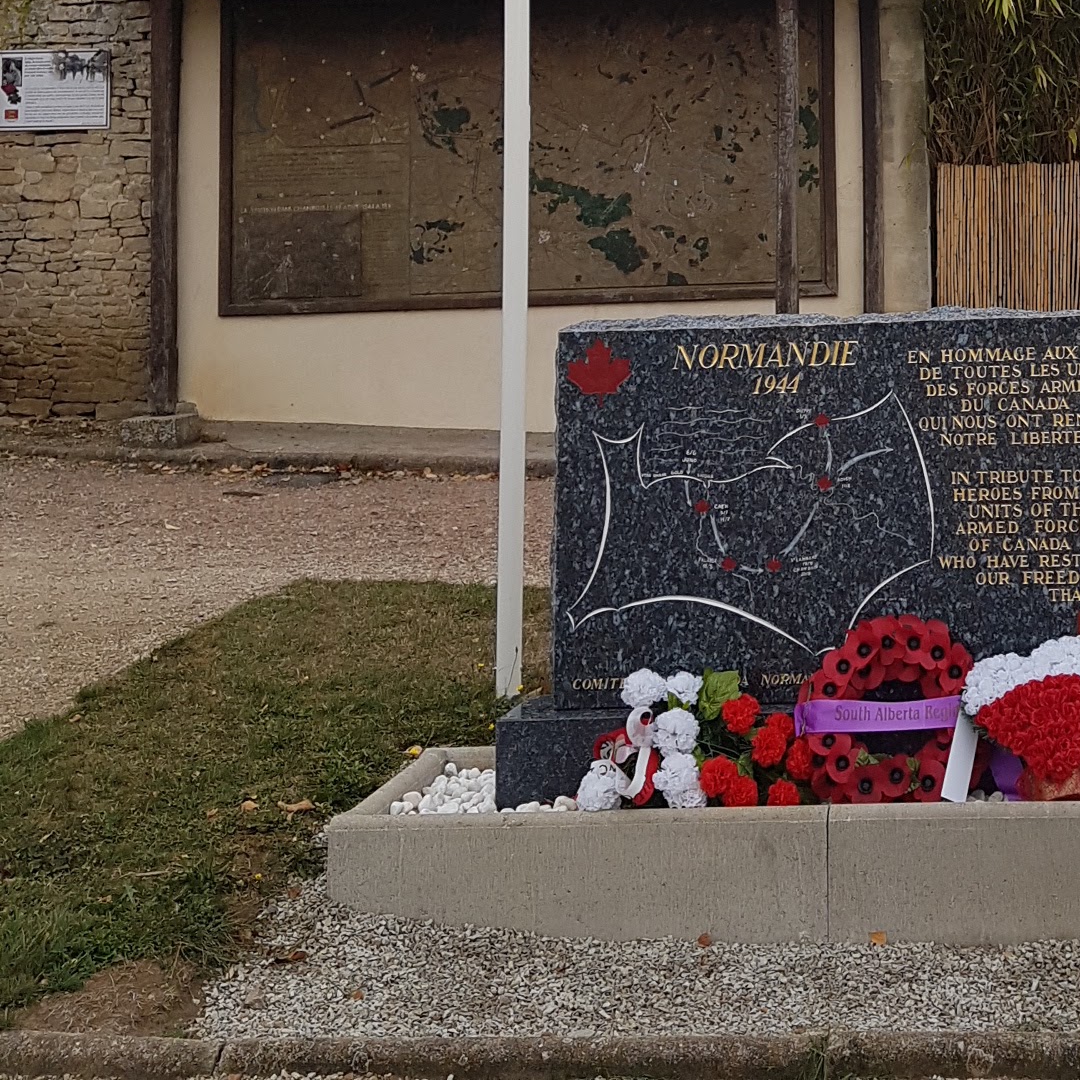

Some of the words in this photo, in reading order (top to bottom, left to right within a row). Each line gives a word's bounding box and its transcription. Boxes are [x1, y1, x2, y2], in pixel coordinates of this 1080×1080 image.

[672, 340, 859, 370] NORMANDIE
[907, 350, 930, 364] EN
[941, 347, 1036, 363] HOMMAGE
[1042, 346, 1078, 360] AUX
[920, 367, 942, 381] DE
[951, 364, 1022, 379] TOUTES
[1030, 363, 1060, 377] LES
[752, 372, 801, 395] 1944
[926, 383, 958, 397] DES
[967, 381, 1030, 395] FORCES
[960, 399, 983, 412] DU
[998, 397, 1070, 411] CANADA
[918, 417, 948, 431] QUI
[952, 415, 997, 430] NOUS
[1006, 414, 1043, 428] ONT
[939, 432, 997, 446] NOTRE
[951, 471, 971, 485] IN
[976, 470, 1054, 484] TRIBUTE
[953, 487, 1023, 502] HEROES
[1031, 487, 1079, 500] FROM
[969, 504, 1023, 519] UNITS
[1030, 504, 1053, 517] OF
[956, 522, 1019, 535] ARMED
[969, 539, 991, 552] OF
[1003, 538, 1071, 552] CANADA
[938, 556, 976, 569] WHO
[987, 555, 1029, 568] HAVE
[976, 573, 1010, 585] OUR
[761, 673, 814, 686] NORMA
[835, 705, 870, 721] South
[874, 707, 920, 721] Alberta
